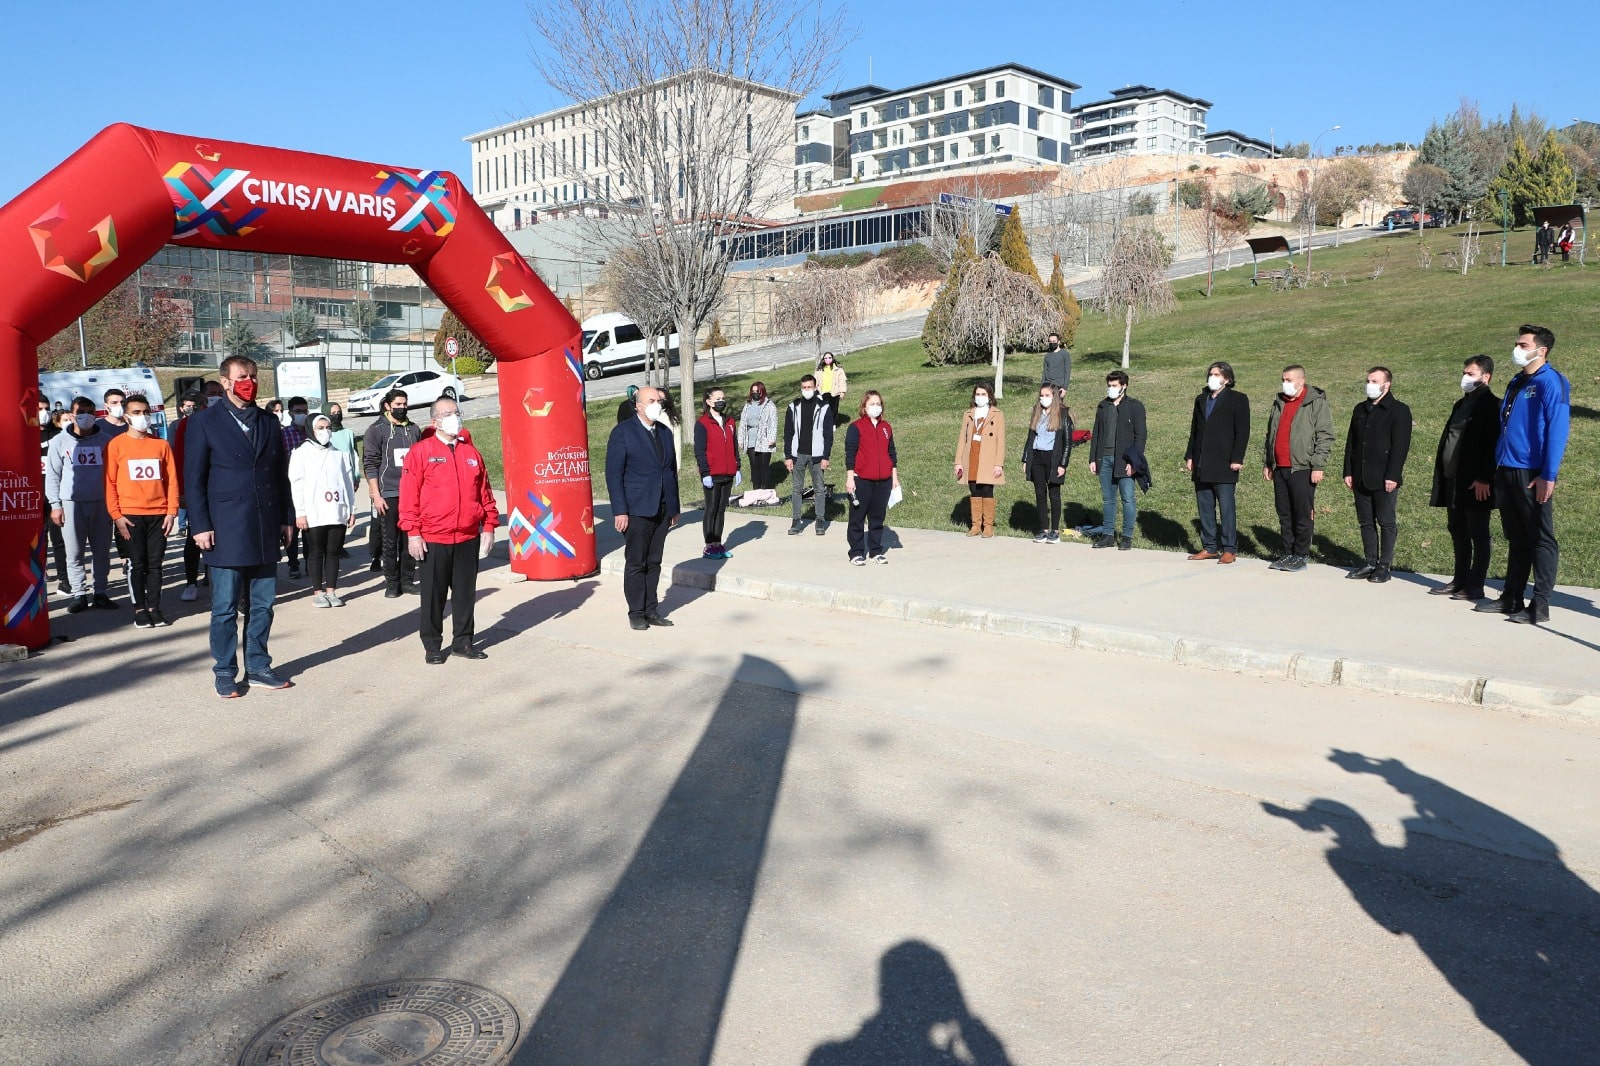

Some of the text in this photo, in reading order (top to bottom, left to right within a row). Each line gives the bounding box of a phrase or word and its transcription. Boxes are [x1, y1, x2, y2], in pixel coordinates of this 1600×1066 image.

[242, 178, 396, 221] ÇIKIŞ/VARIŞ
[77, 452, 97, 465] 02
[135, 466, 154, 478] 20
[325, 491, 340, 502] 03
